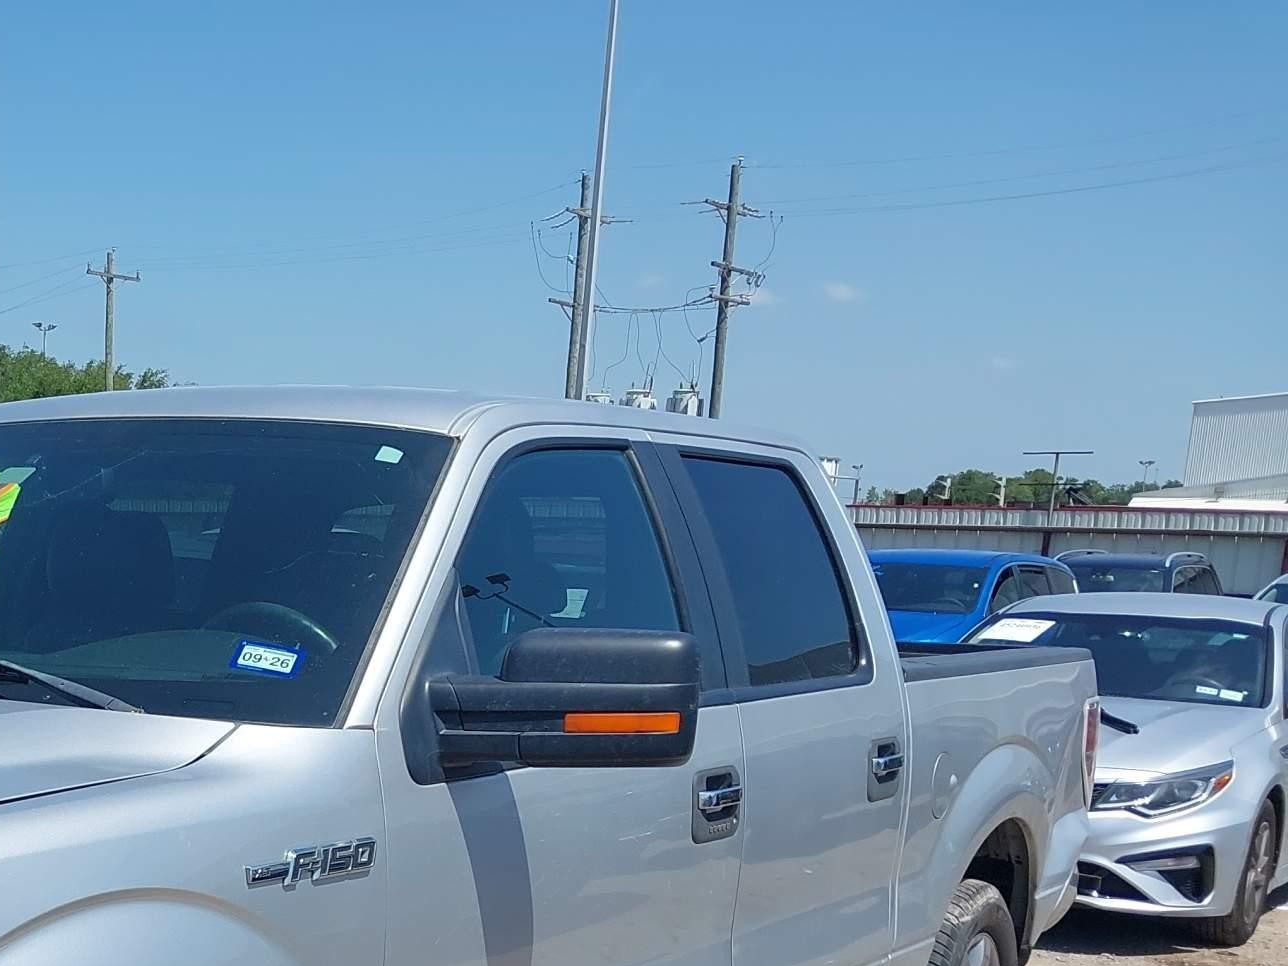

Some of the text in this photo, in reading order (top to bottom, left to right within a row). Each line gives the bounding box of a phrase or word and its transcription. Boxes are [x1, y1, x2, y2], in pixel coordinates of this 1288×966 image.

[242, 651, 291, 669] 09 26
[283, 837, 377, 886] F-150
